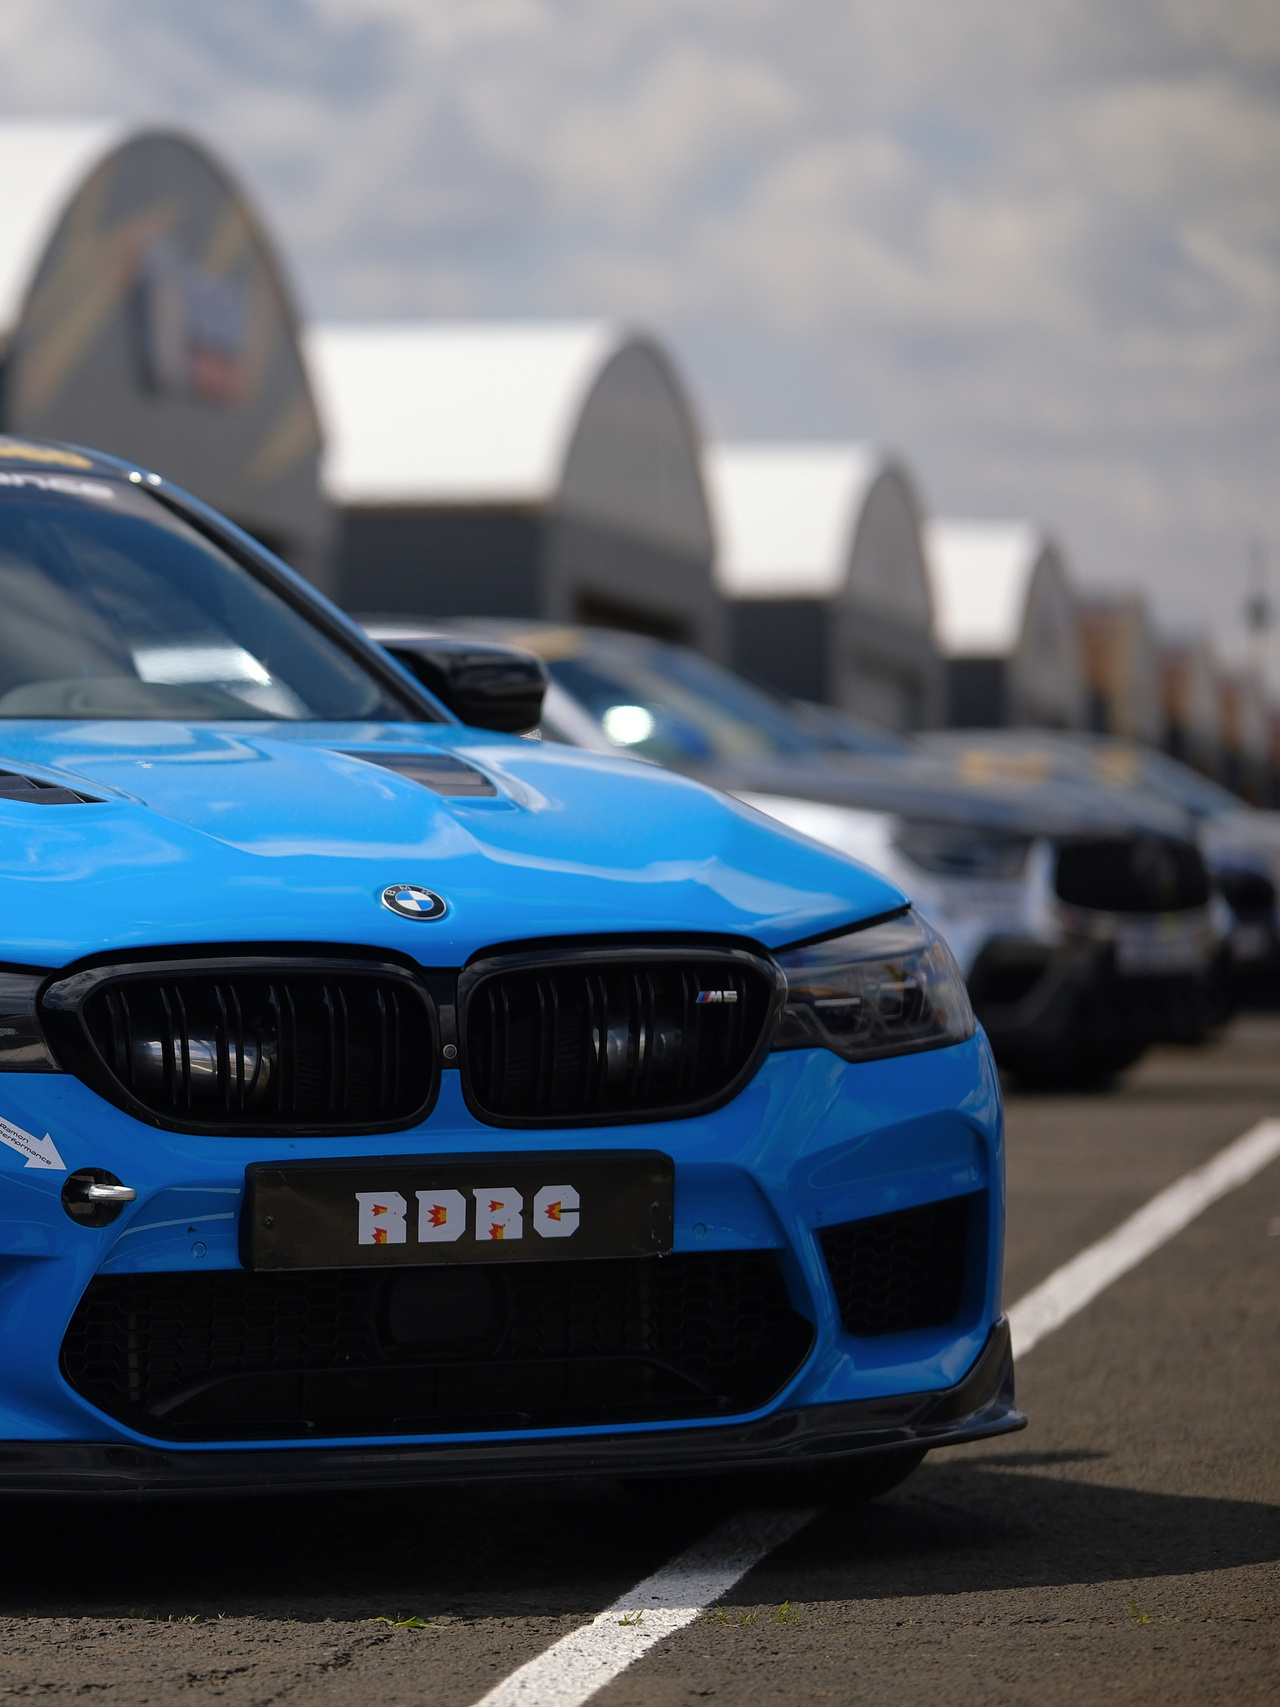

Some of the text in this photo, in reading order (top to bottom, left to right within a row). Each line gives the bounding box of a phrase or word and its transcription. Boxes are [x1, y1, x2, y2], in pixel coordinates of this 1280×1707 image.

[385, 885, 433, 896] BMW
[707, 990, 738, 1003] M5
[0, 1122, 29, 1144] Ramon
[355, 1184, 580, 1245] RDRC
